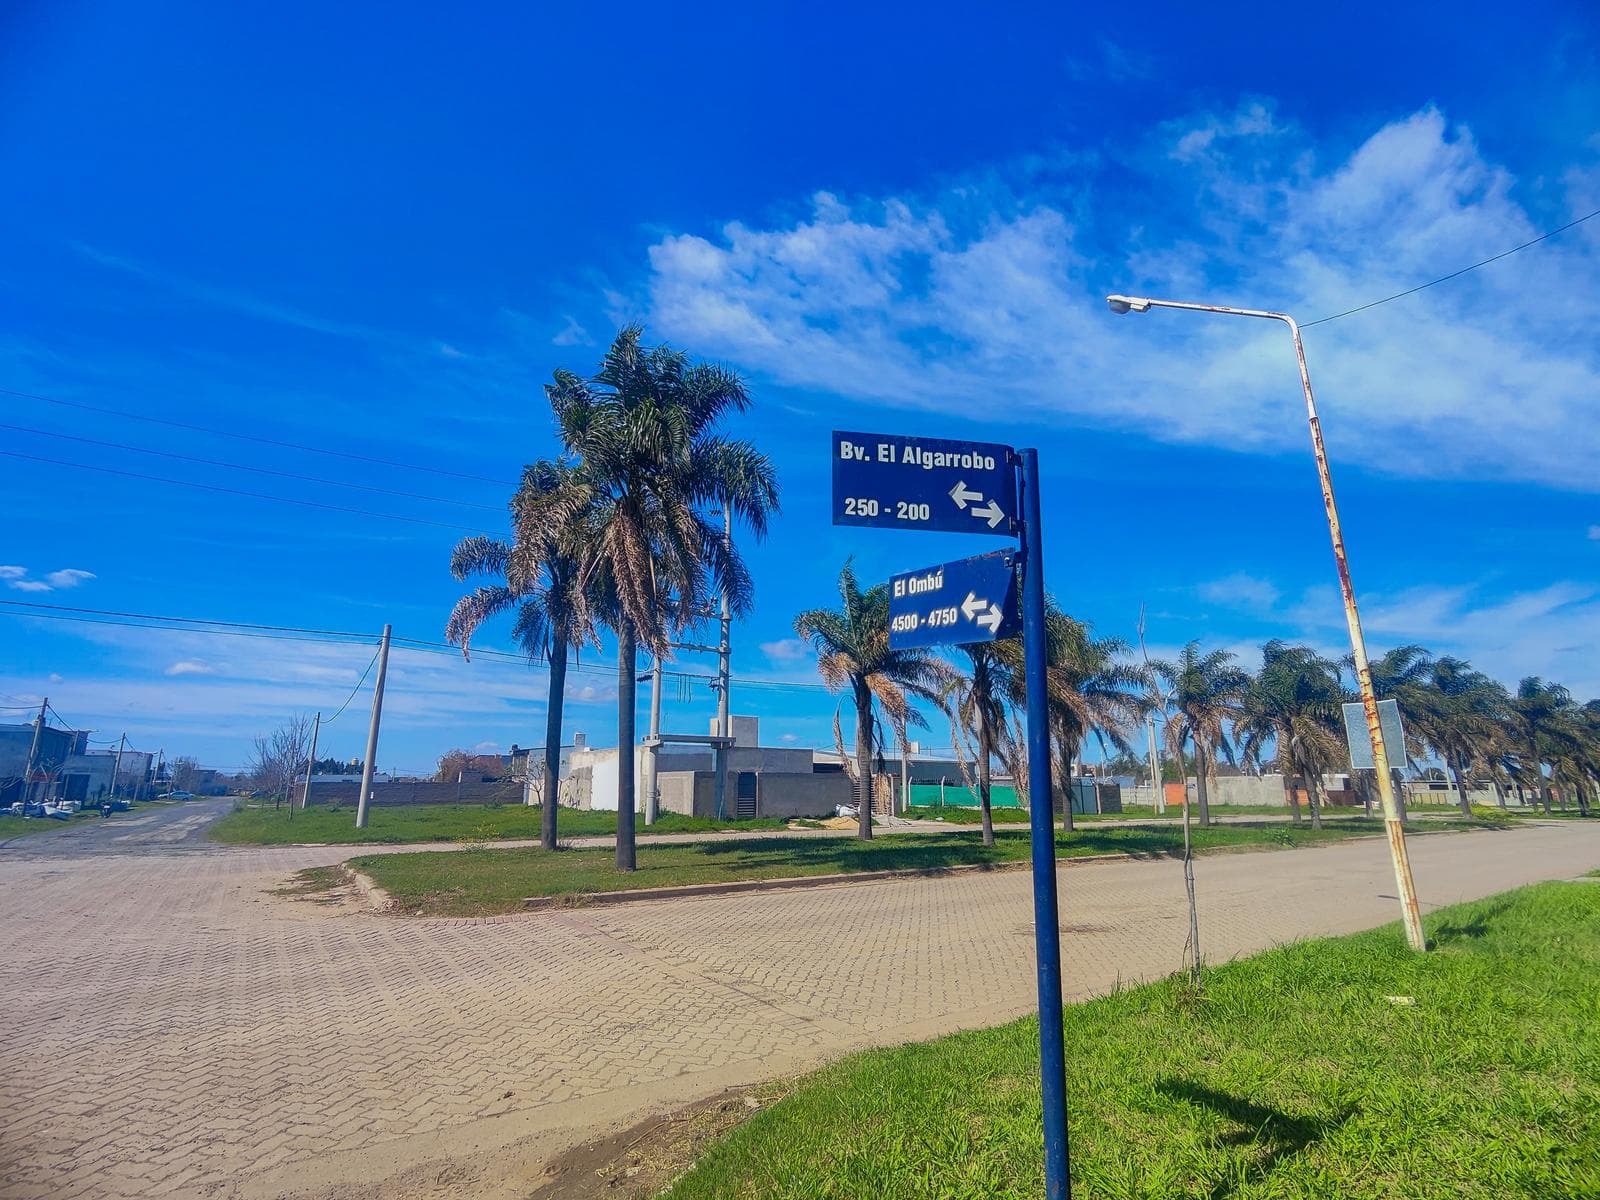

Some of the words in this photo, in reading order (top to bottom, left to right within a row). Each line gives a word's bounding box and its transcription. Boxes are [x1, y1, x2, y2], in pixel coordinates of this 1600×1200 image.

[840, 441, 870, 462] Bv.
[877, 443, 896, 463] El
[902, 446, 995, 470] Algarrobo
[844, 497, 879, 517] 250
[897, 501, 930, 521] 200
[894, 579, 906, 598] El
[908, 570, 943, 595] Ombú
[891, 613, 918, 632] 4500
[927, 607, 958, 627] 4750
